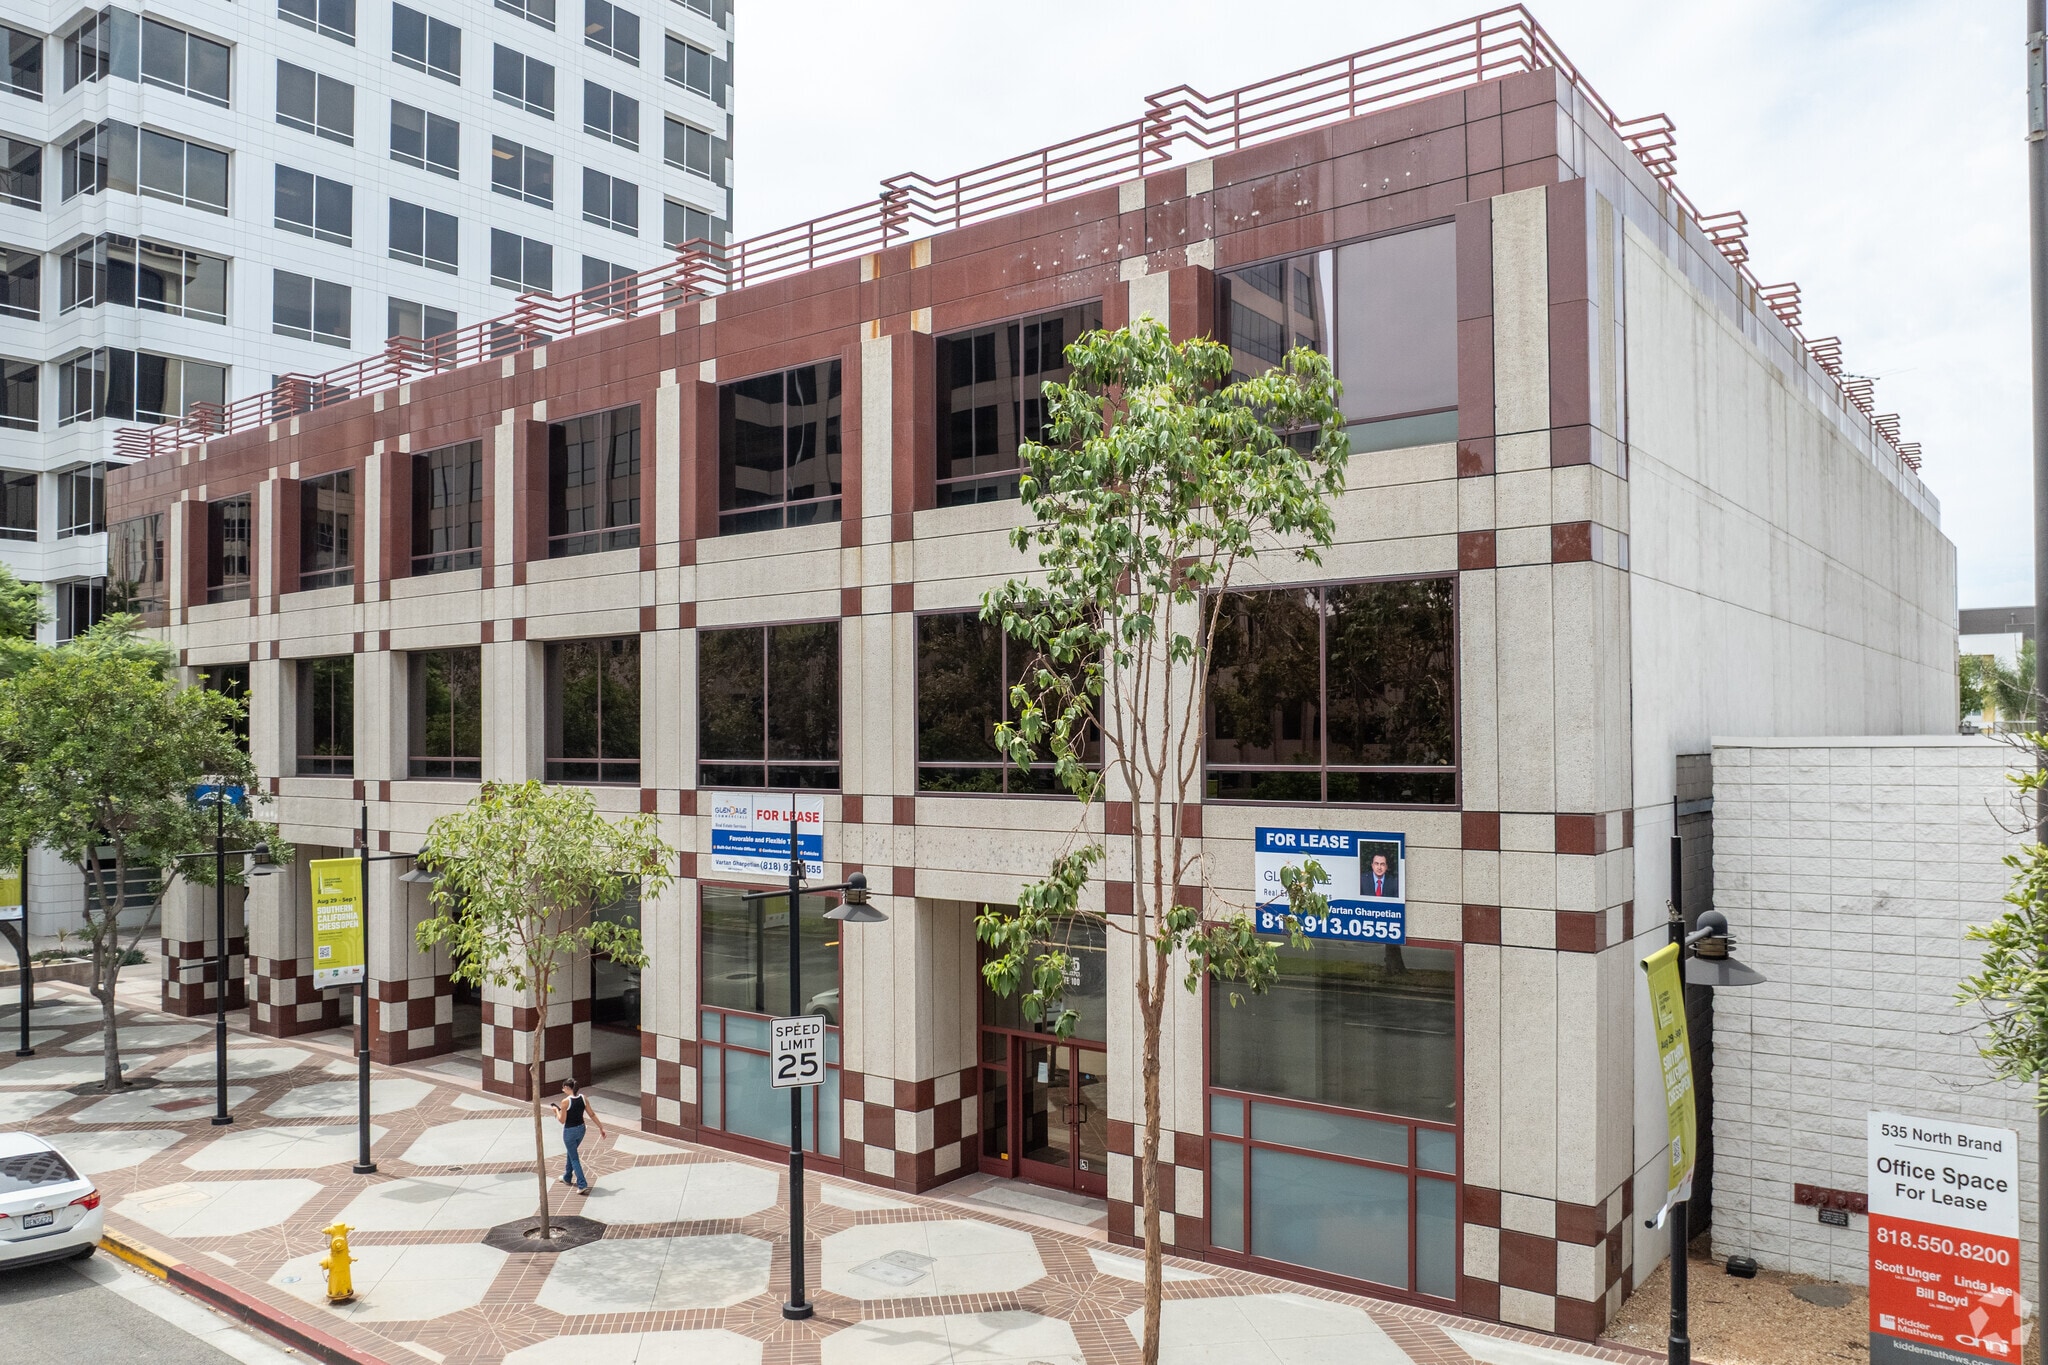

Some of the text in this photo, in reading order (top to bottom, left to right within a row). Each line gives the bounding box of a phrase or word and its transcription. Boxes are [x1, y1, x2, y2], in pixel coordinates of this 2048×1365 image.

[757, 809, 819, 823] FOR LEASE
[1266, 833, 1349, 849] FOR LEASE
[760, 861, 781, 872] (818)
[1264, 889, 1278, 897] Real
[317, 904, 353, 915] SOUTHERN
[318, 912, 358, 922] CALIFORNIA
[1328, 906, 1401, 919] Vartan Gharpetian
[318, 919, 358, 931] CHESS OPEN
[1262, 913, 1401, 940] 81.913.0555
[1072, 978, 1080, 986] 100
[776, 1024, 820, 1037] SPEED
[781, 1038, 815, 1050] LIMIT
[778, 1052, 818, 1079] 25
[1881, 1124, 2002, 1152] 535 North Brand
[1877, 1157, 2008, 1193] Office Space
[1895, 1183, 1987, 1211] For Lease
[1877, 1227, 2010, 1267] 818.550.8200
[1875, 1260, 1904, 1275] Scott
[1907, 1265, 1941, 1282] Unger
[1954, 1275, 1987, 1292] Linda
[1990, 1283, 2013, 1296] Lee
[1916, 1287, 1934, 1300] Bill
[1938, 1292, 1968, 1307] Boyd
[1898, 1317, 1931, 1330] Kidder
[1898, 1325, 1944, 1341] Mathews
[1955, 1334, 2009, 1353] onni
